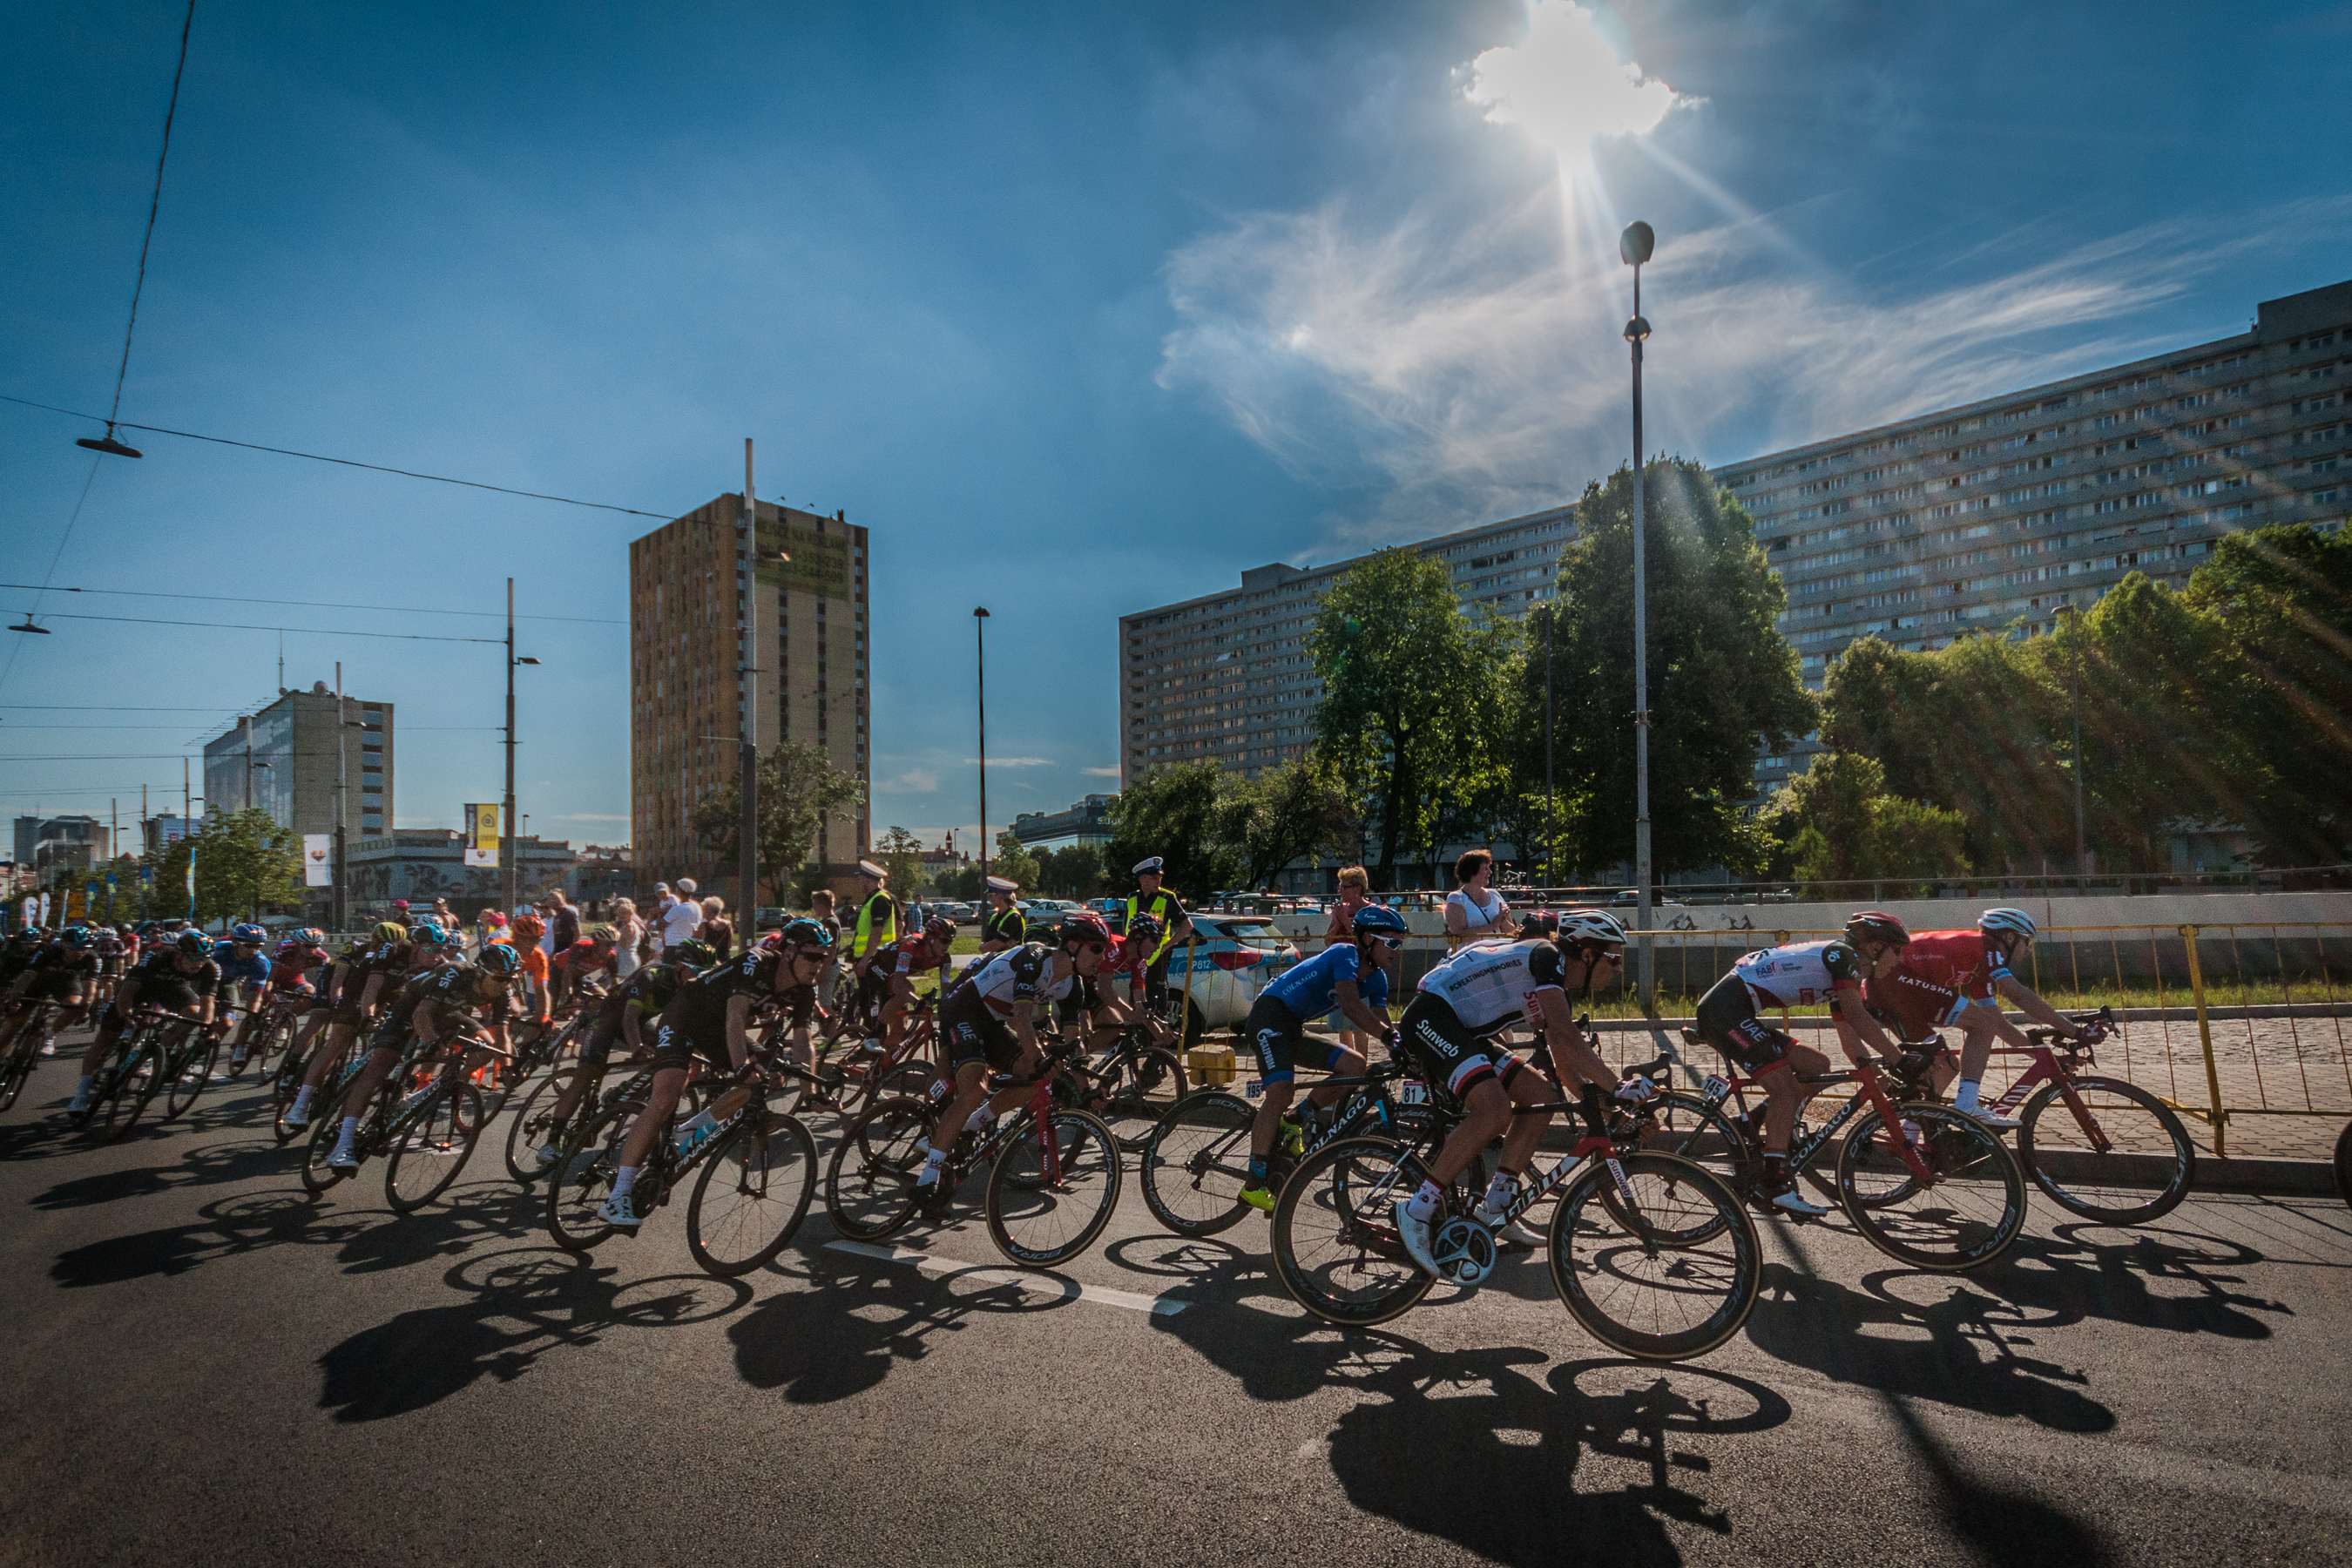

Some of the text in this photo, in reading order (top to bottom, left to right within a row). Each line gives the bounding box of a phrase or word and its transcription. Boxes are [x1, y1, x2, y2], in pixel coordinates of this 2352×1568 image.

[438, 964, 461, 990] sky
[742, 953, 759, 977] sky
[1281, 970, 1320, 997] COLNAGO
[1897, 975, 1953, 997] KATUSHA
[956, 1022, 977, 1041] UAE
[1416, 1018, 1460, 1058] Sunweb
[1740, 1018, 1767, 1043] UAE
[1404, 1086, 1416, 1103] 81
[1703, 1080, 1721, 1096] 145
[674, 1107, 744, 1173] PINARELLO
[1790, 1103, 1853, 1168] COLNAGO
[1605, 1158, 1632, 1198] Sunweb
